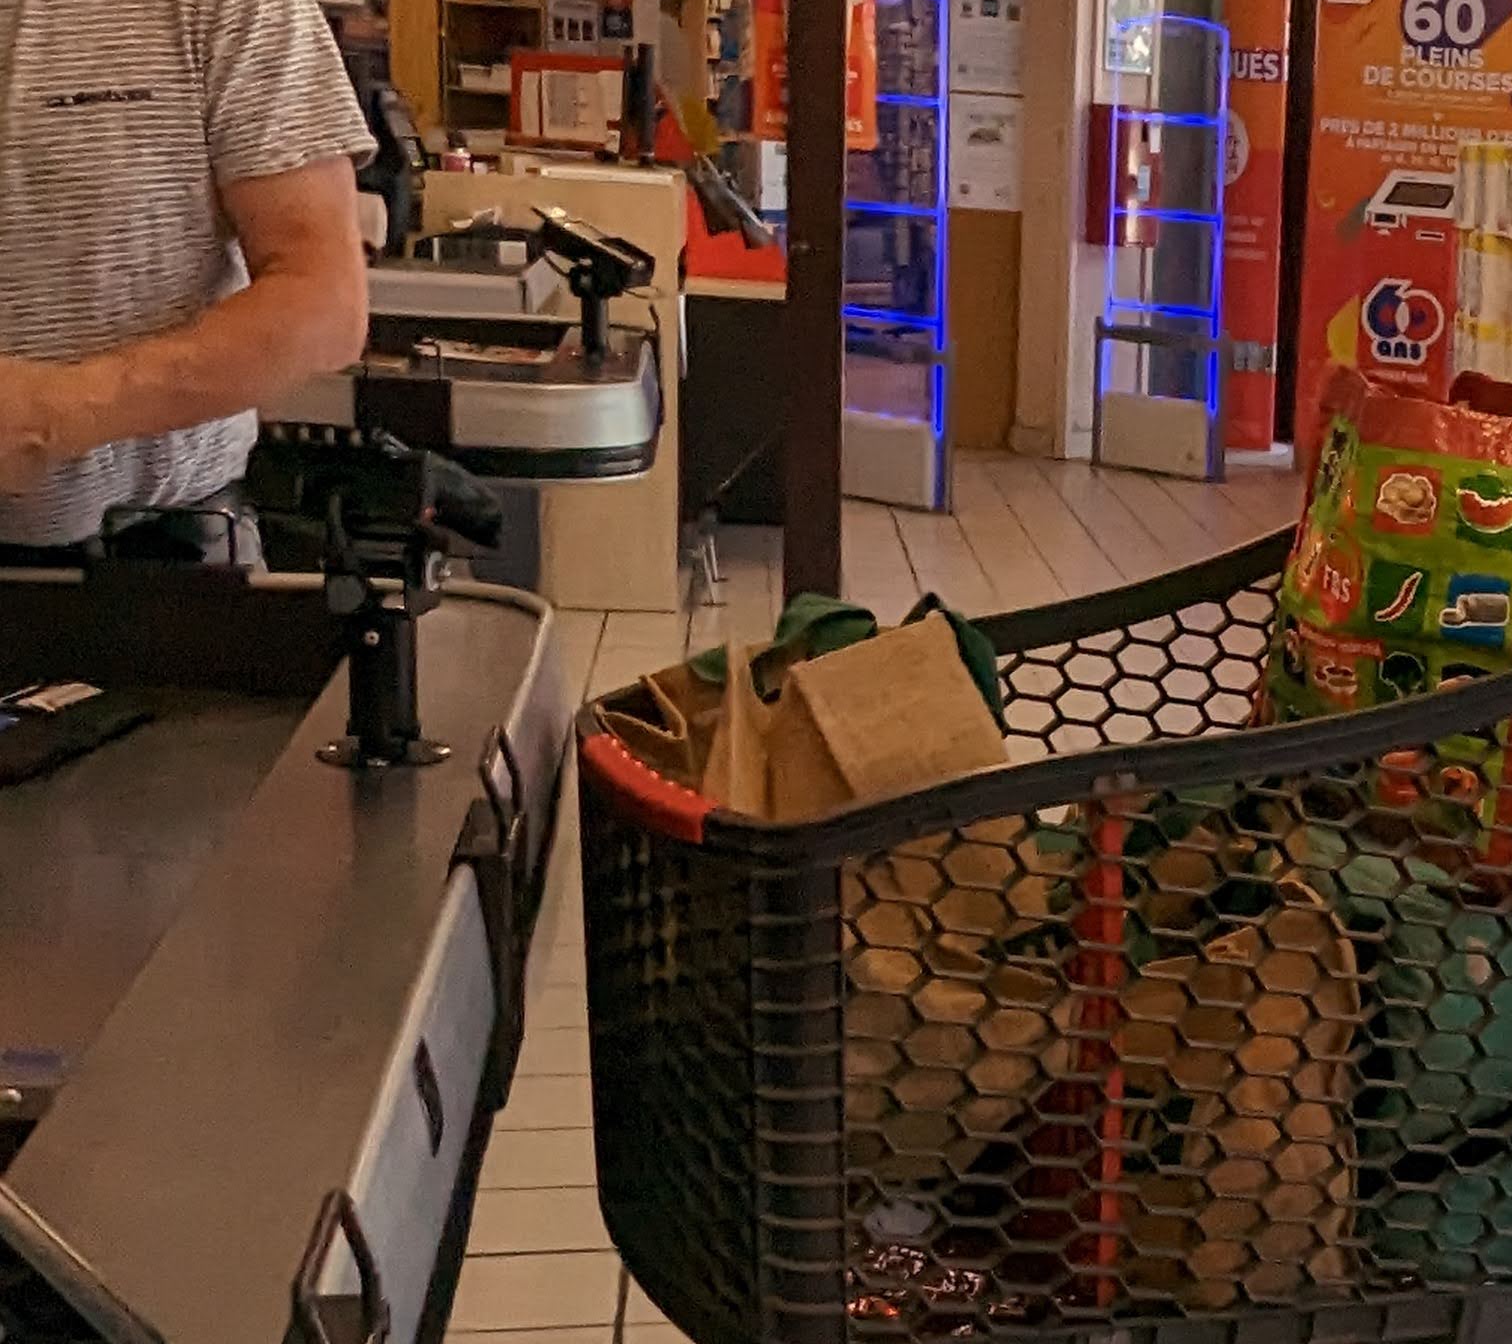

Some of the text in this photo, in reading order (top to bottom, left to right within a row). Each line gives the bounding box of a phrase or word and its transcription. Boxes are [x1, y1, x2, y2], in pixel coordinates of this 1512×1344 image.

[1401, 45, 1484, 69] PLEINS
[1363, 66, 1395, 86] DE
[1377, 340, 1422, 360] ans
